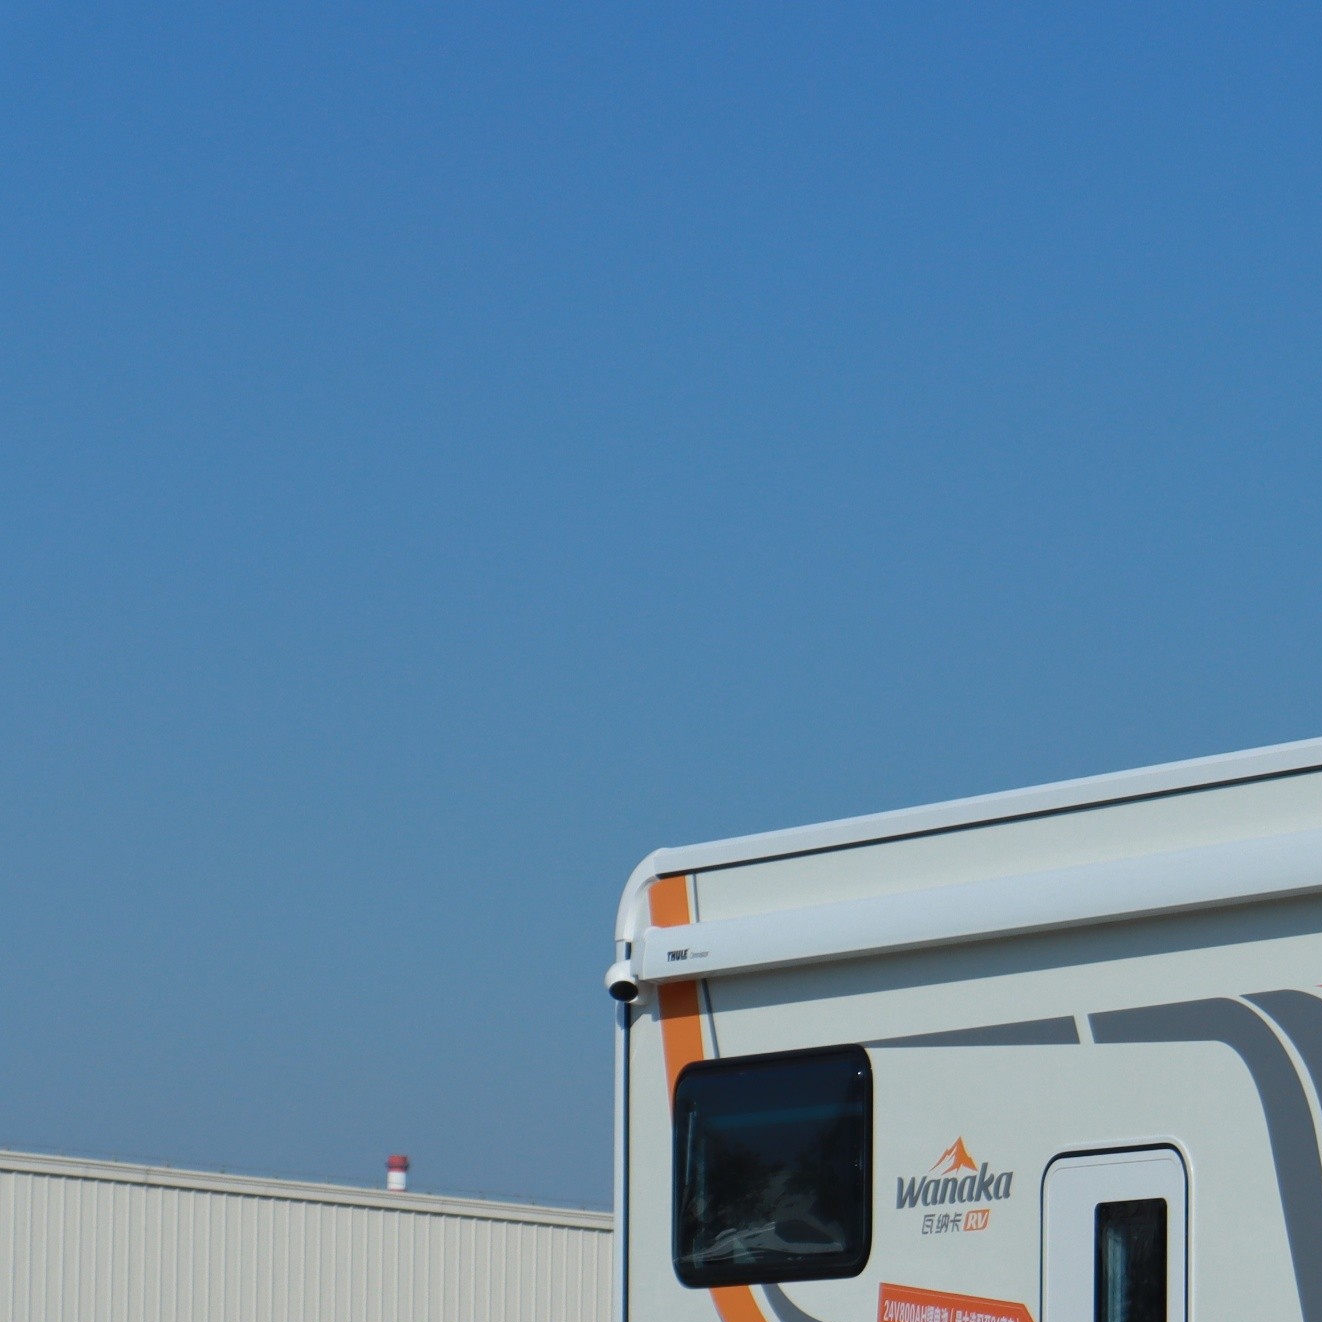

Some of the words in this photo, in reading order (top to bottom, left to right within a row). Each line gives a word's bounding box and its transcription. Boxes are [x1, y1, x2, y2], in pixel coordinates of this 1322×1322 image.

[896, 1162, 1013, 1209] Wanaka
[921, 1212, 962, 1234] 瓦纳卡
[964, 1209, 990, 1231] RV
